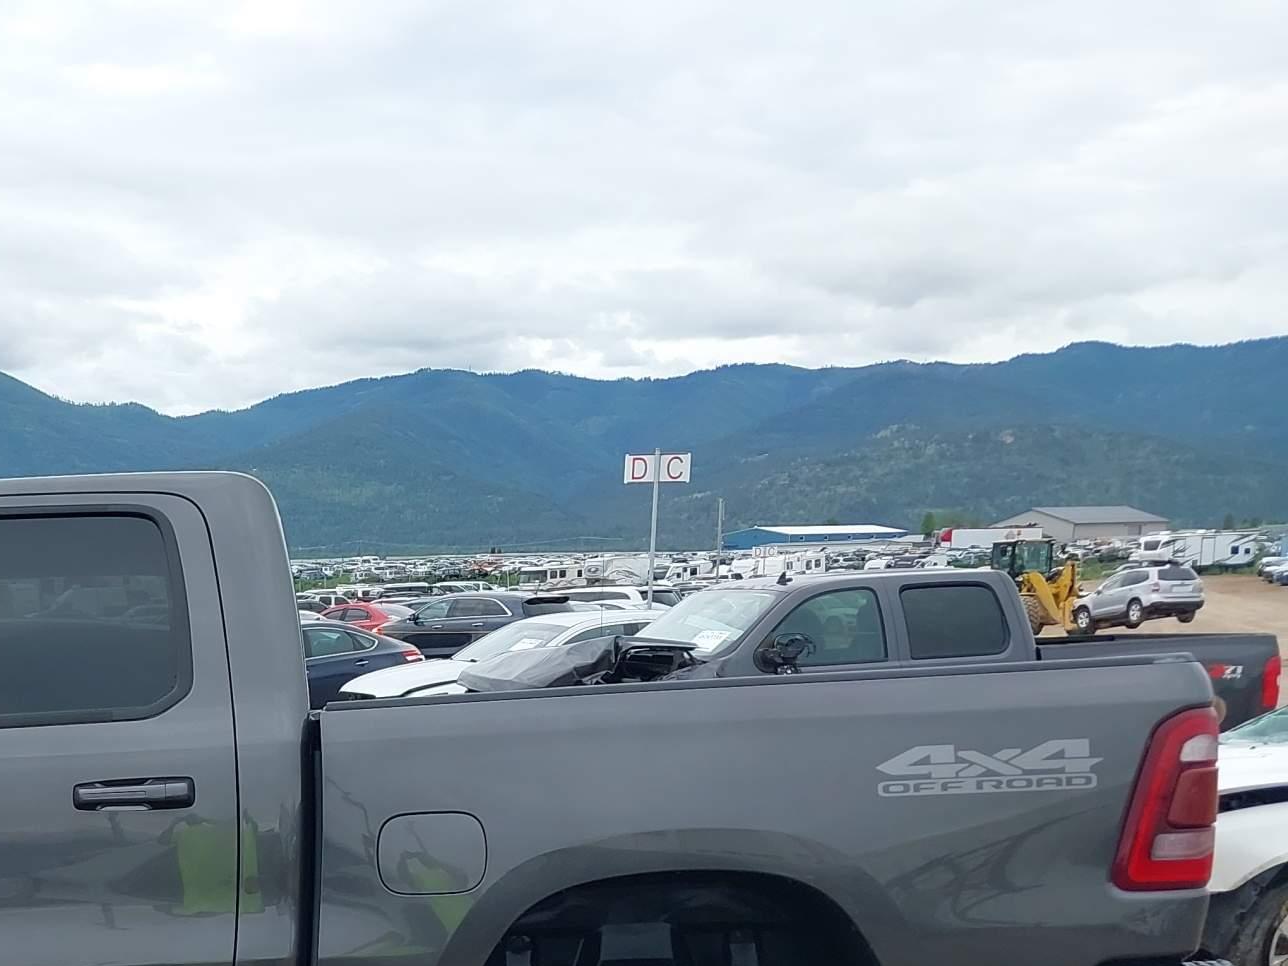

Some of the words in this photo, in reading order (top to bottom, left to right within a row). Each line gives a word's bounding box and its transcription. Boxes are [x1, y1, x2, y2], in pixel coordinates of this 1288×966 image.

[632, 457, 648, 480] D
[667, 456, 684, 480] C
[881, 779, 968, 795] OFF
[975, 774, 1094, 791] ROAD
